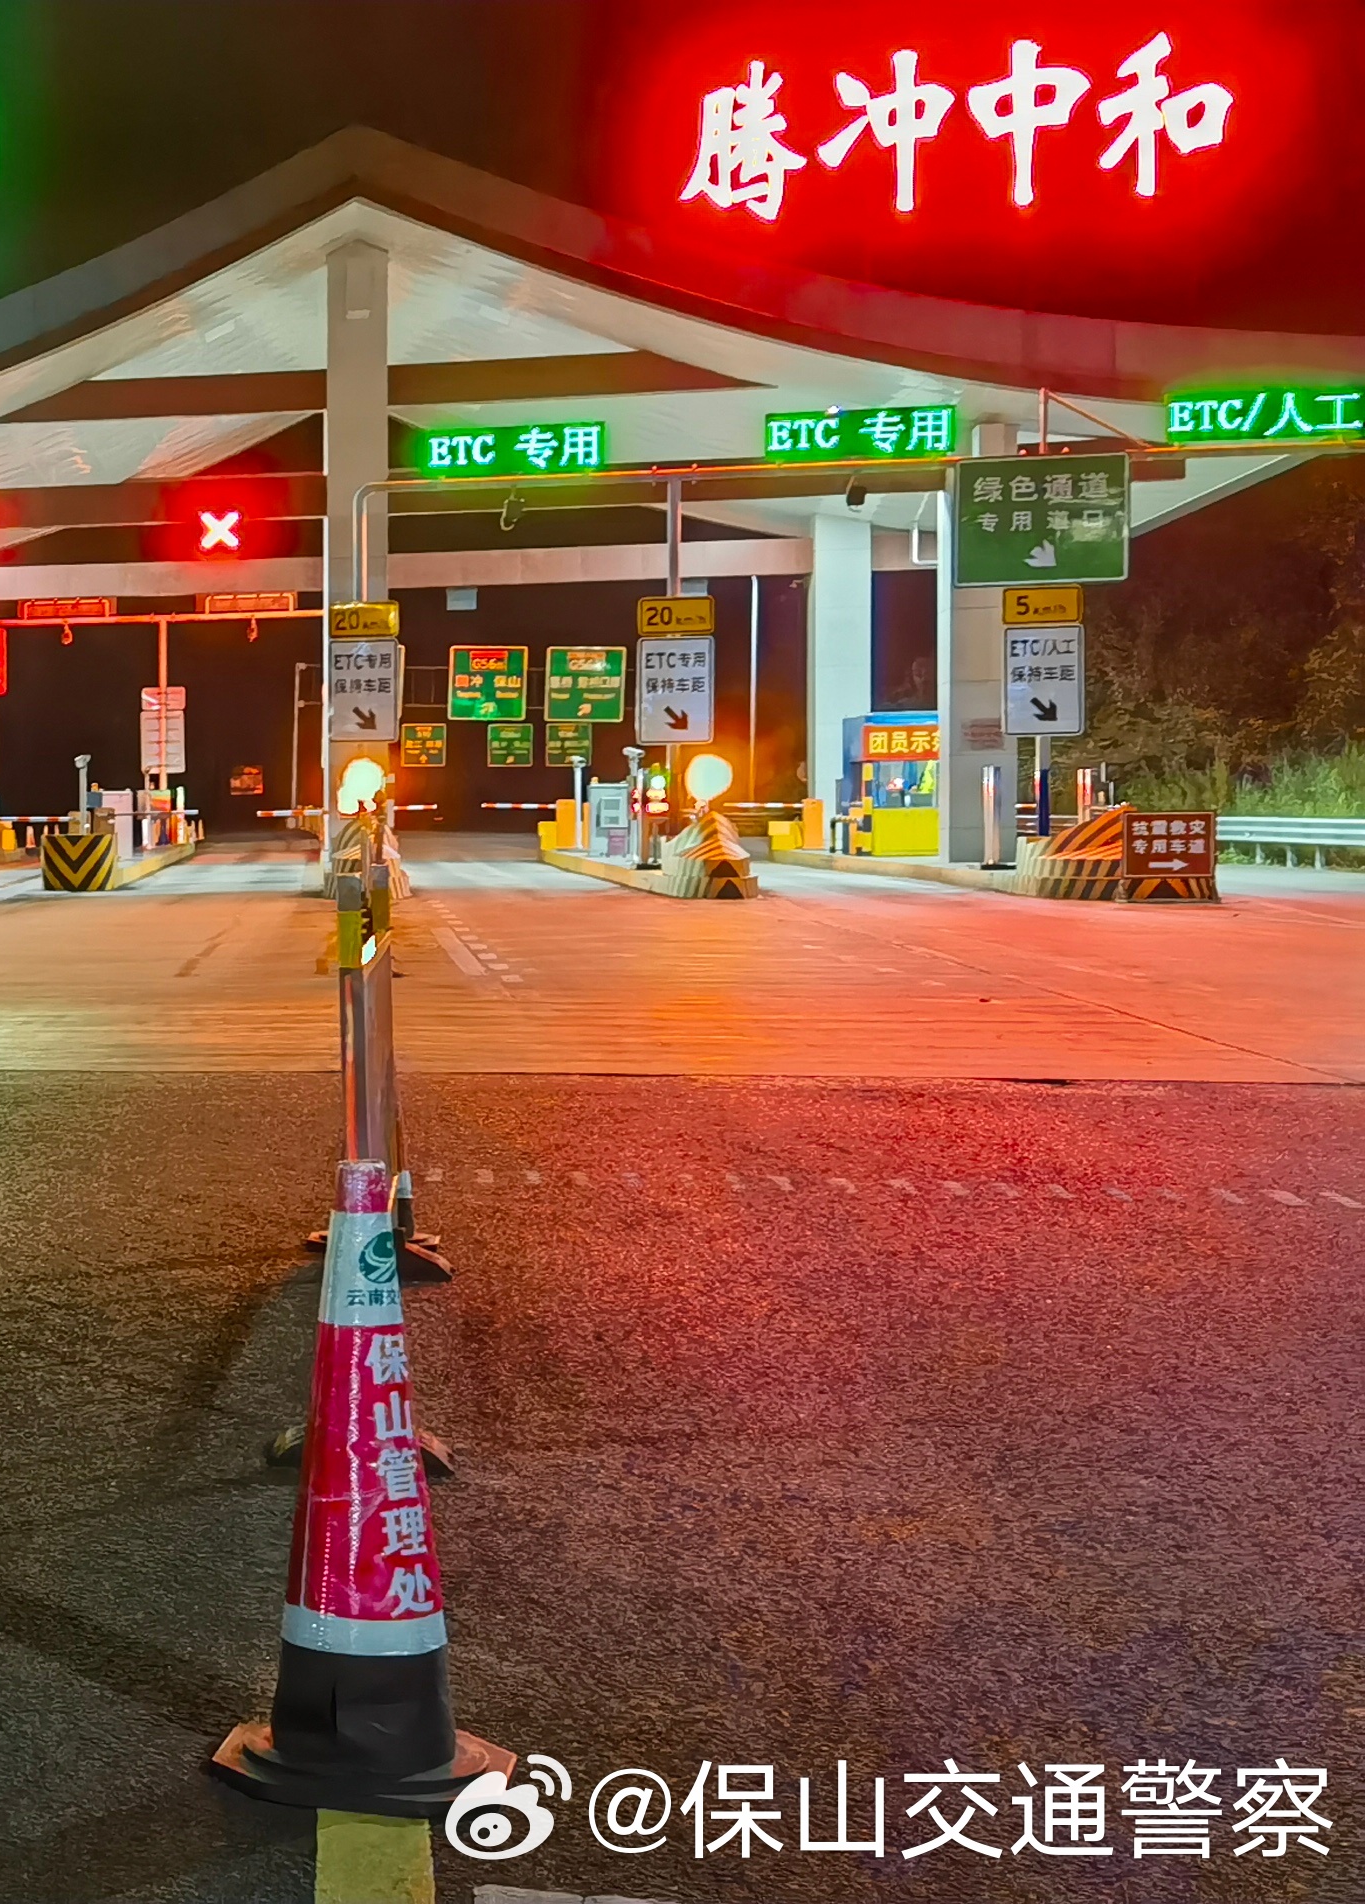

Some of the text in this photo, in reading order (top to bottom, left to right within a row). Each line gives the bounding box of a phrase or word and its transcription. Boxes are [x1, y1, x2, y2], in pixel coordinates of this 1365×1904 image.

[679, 31, 1234, 221] 腾冲中和
[1167, 392, 1364, 436] ETC/人工
[768, 409, 952, 451] ETC 专用
[428, 424, 601, 469] ETC 专用
[973, 472, 1111, 503] 绿色通道
[1016, 595, 1031, 616] 5
[334, 611, 361, 631] 20
[645, 606, 673, 627] 20
[1009, 639, 1076, 658] ETC/人工
[334, 653, 392, 670] ETC专用
[645, 652, 706, 669] ETC专用
[1010, 664, 1076, 683] 保持车距
[646, 676, 706, 694] 保持车距
[347, 1288, 400, 1306] 云南交
[365, 1333, 436, 1617] 保山管理处
